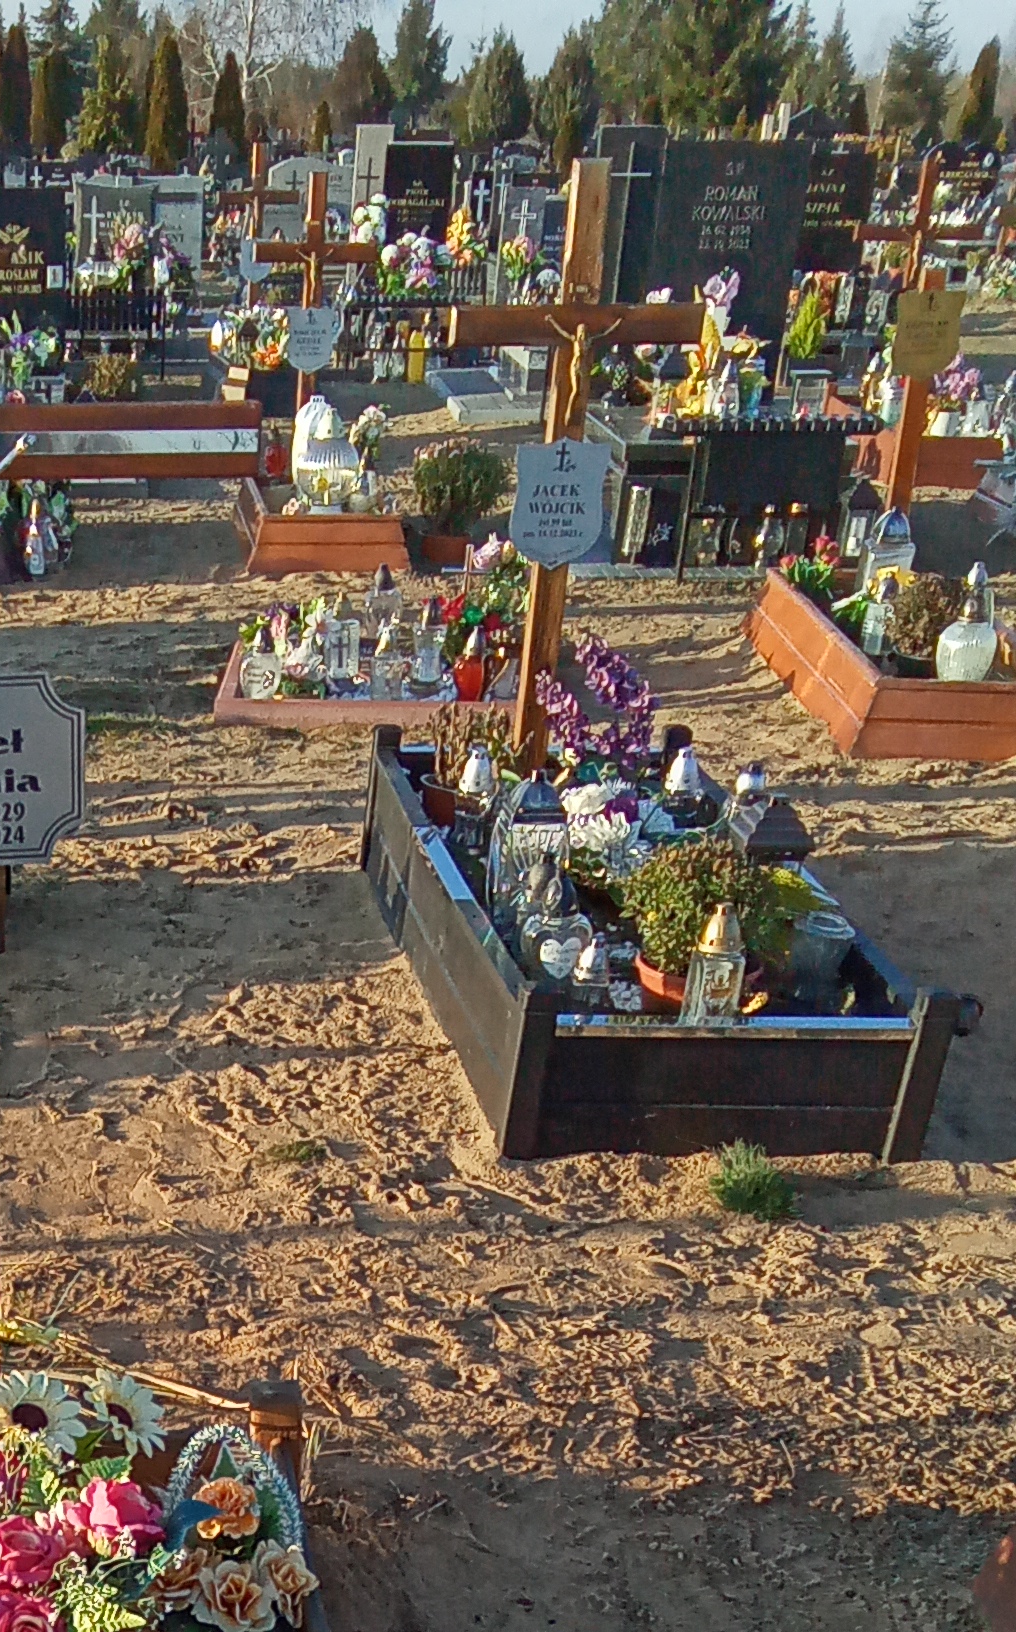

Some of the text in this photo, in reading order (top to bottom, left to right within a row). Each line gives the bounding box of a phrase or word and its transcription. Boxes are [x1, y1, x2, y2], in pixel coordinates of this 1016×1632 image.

[704, 185, 759, 202] ROMAN
[691, 204, 766, 222] KOWALSKI
[533, 484, 581, 497] JACEK
[529, 500, 586, 515] WÓJCIK
